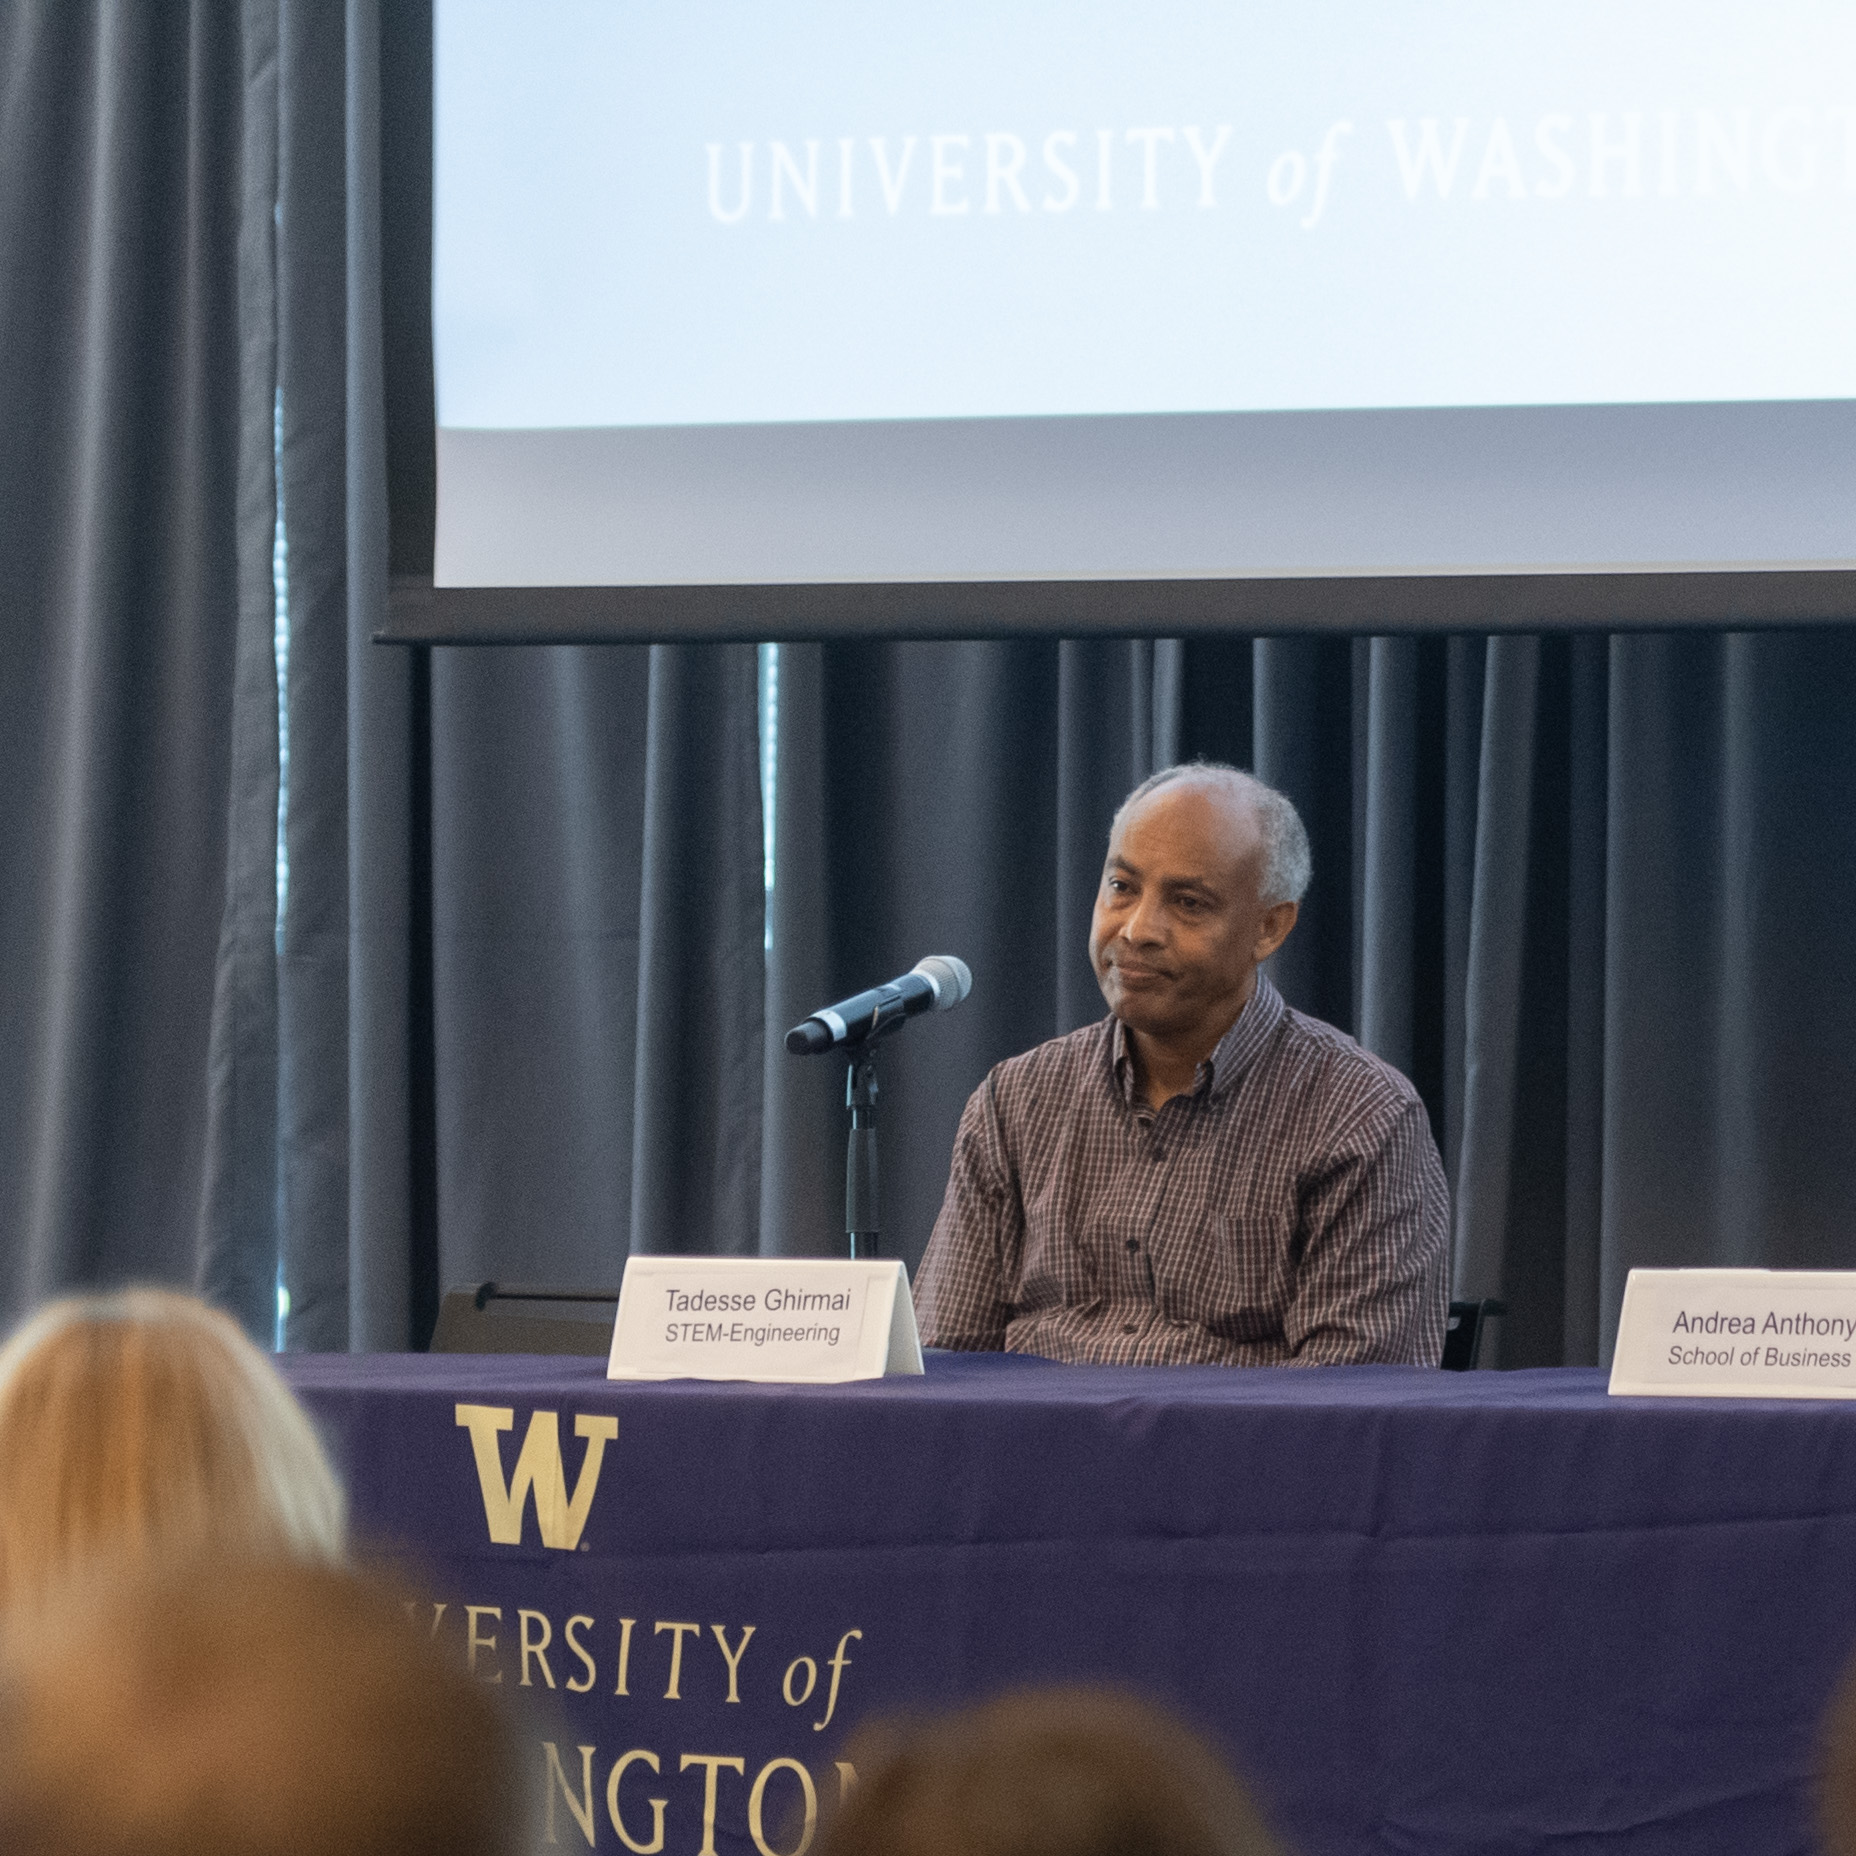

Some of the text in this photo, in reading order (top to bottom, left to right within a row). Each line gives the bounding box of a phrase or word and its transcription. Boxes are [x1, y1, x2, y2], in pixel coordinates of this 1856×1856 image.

[703, 124, 1235, 224] UNIVERSITY
[1265, 119, 1353, 229] of
[665, 1288, 852, 1312] Tadesse Ghirmai
[665, 1322, 840, 1347] STEM-Engineering
[1672, 1310, 1756, 1335] Andrea
[1667, 1345, 1852, 1368] School of Business
[454, 1403, 619, 1551] W
[782, 1629, 863, 1732] of
